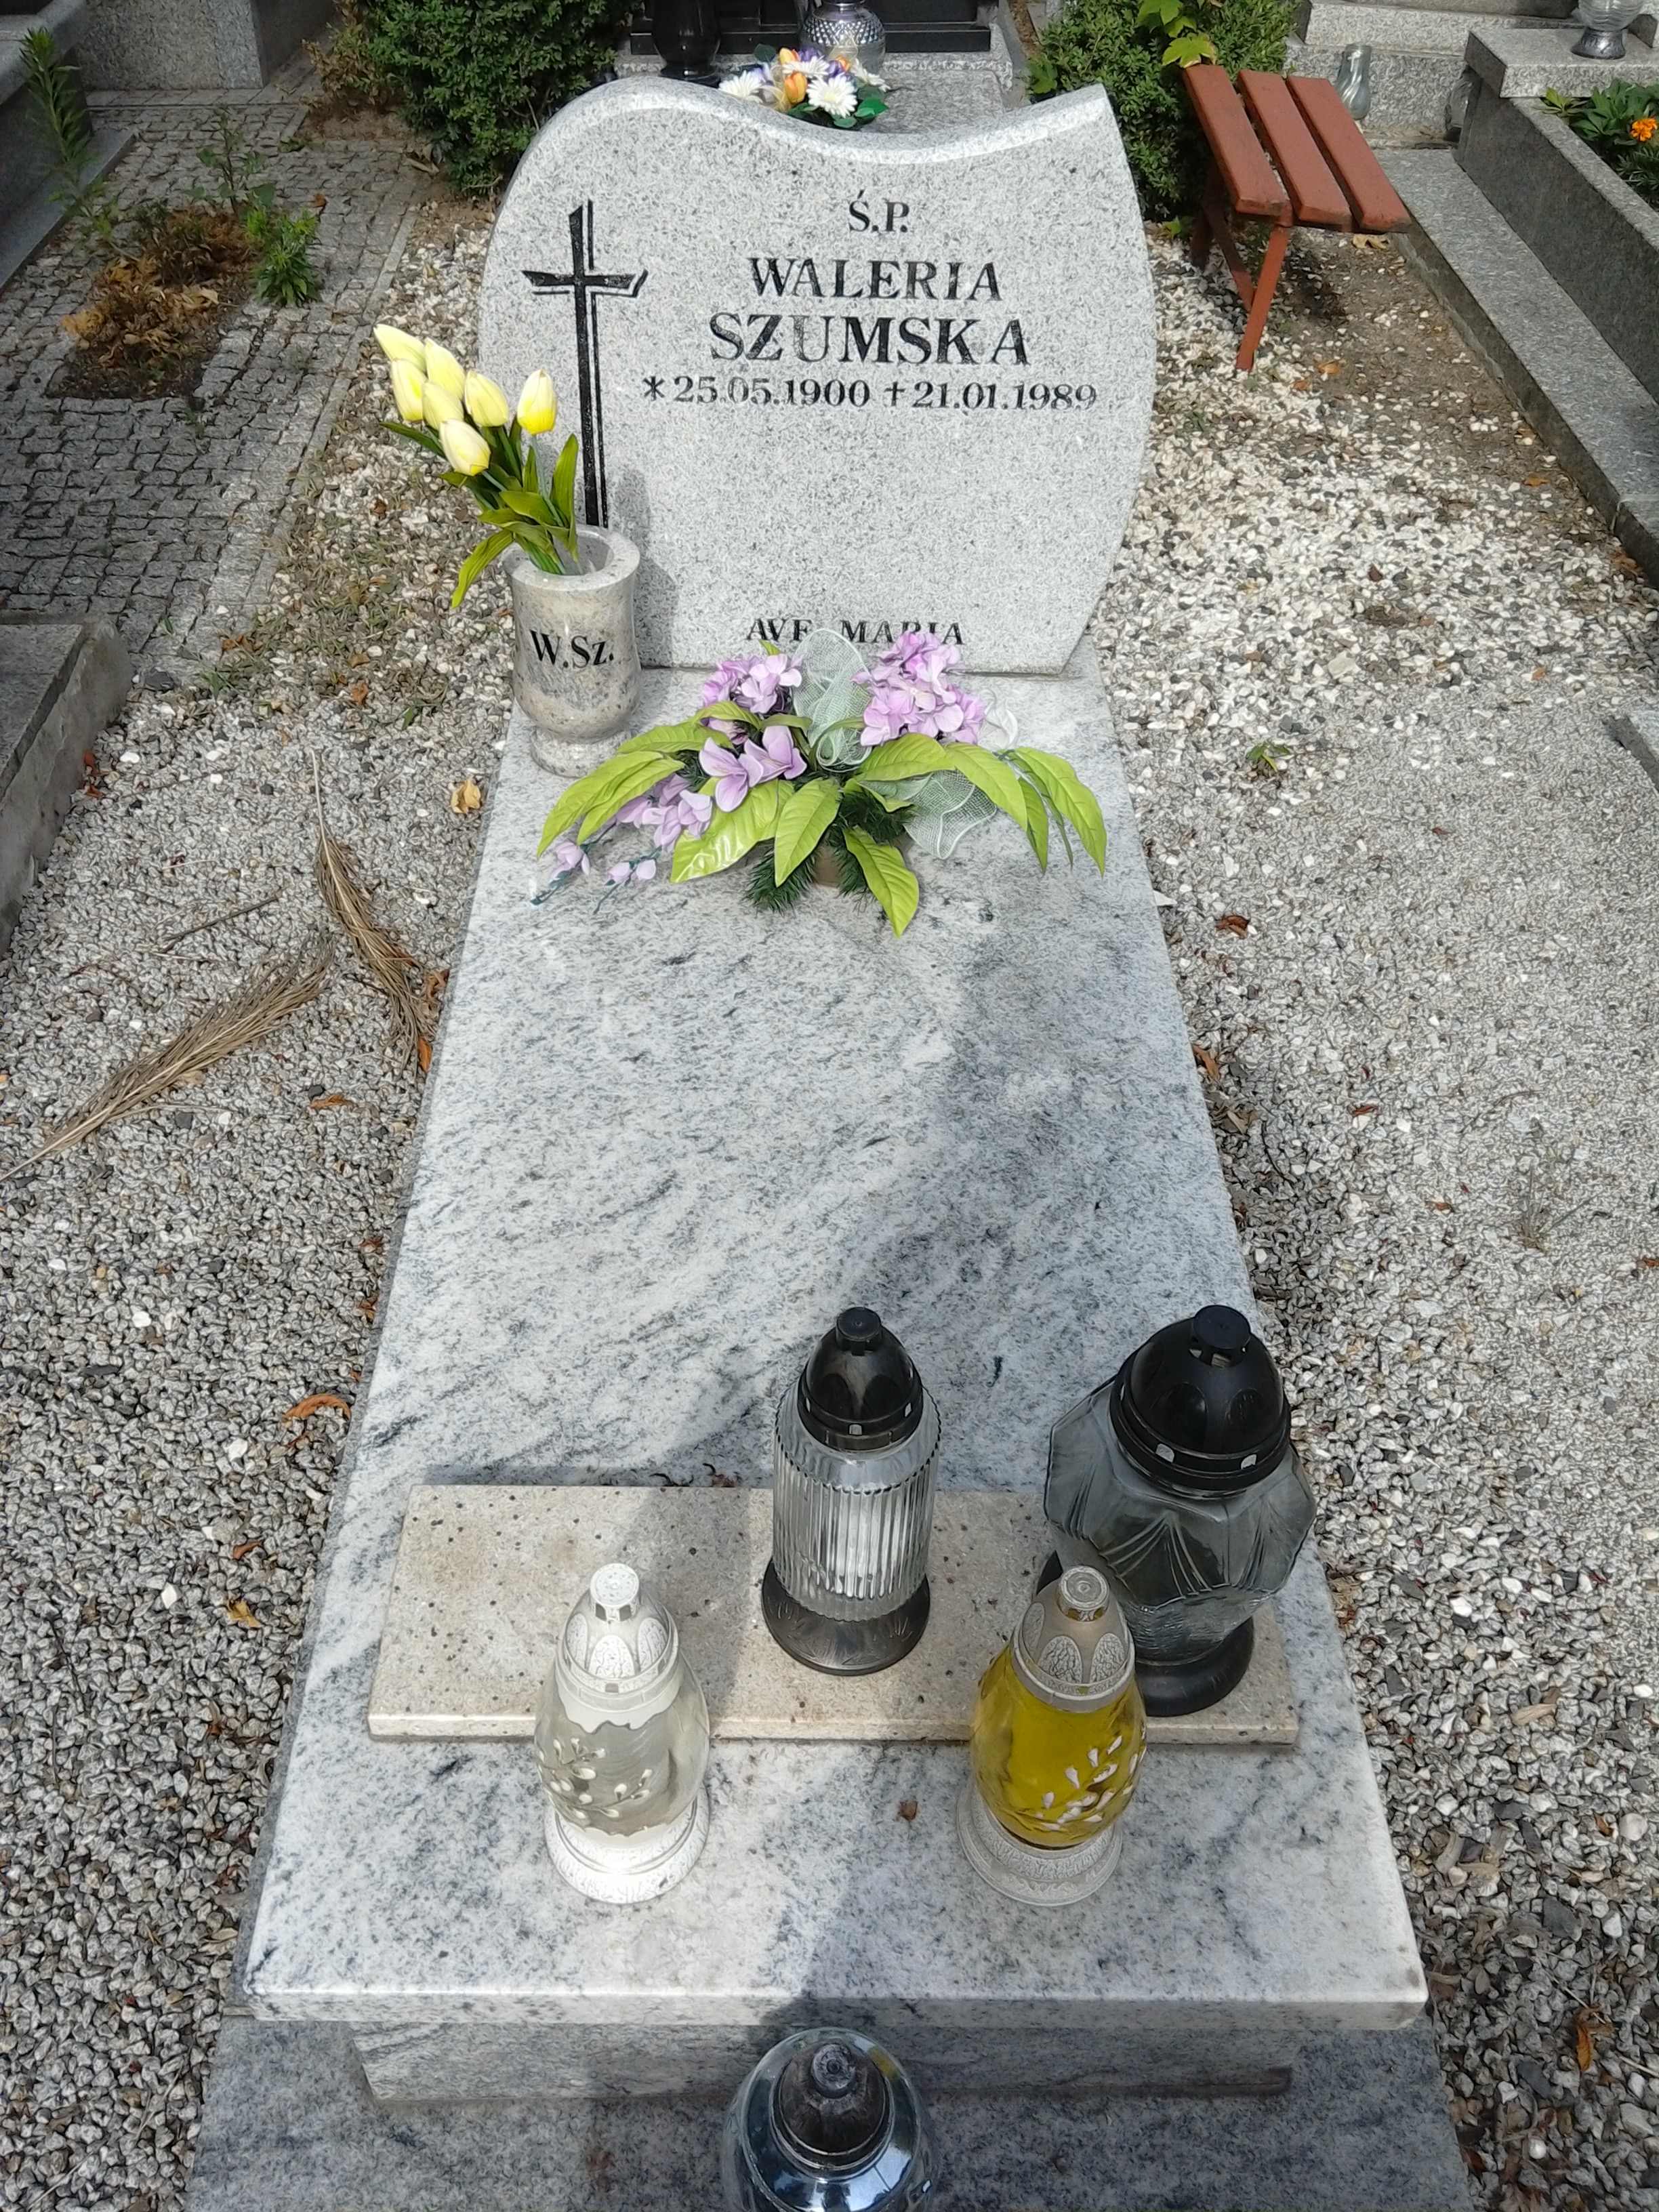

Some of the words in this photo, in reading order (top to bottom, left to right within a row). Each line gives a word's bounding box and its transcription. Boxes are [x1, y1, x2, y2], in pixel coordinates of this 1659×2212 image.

[848, 189, 909, 232] Ś.P.
[747, 257, 1003, 301] WALERIA
[708, 312, 1031, 365] SZUMSKA
[529, 629, 614, 669] W.Sz.
